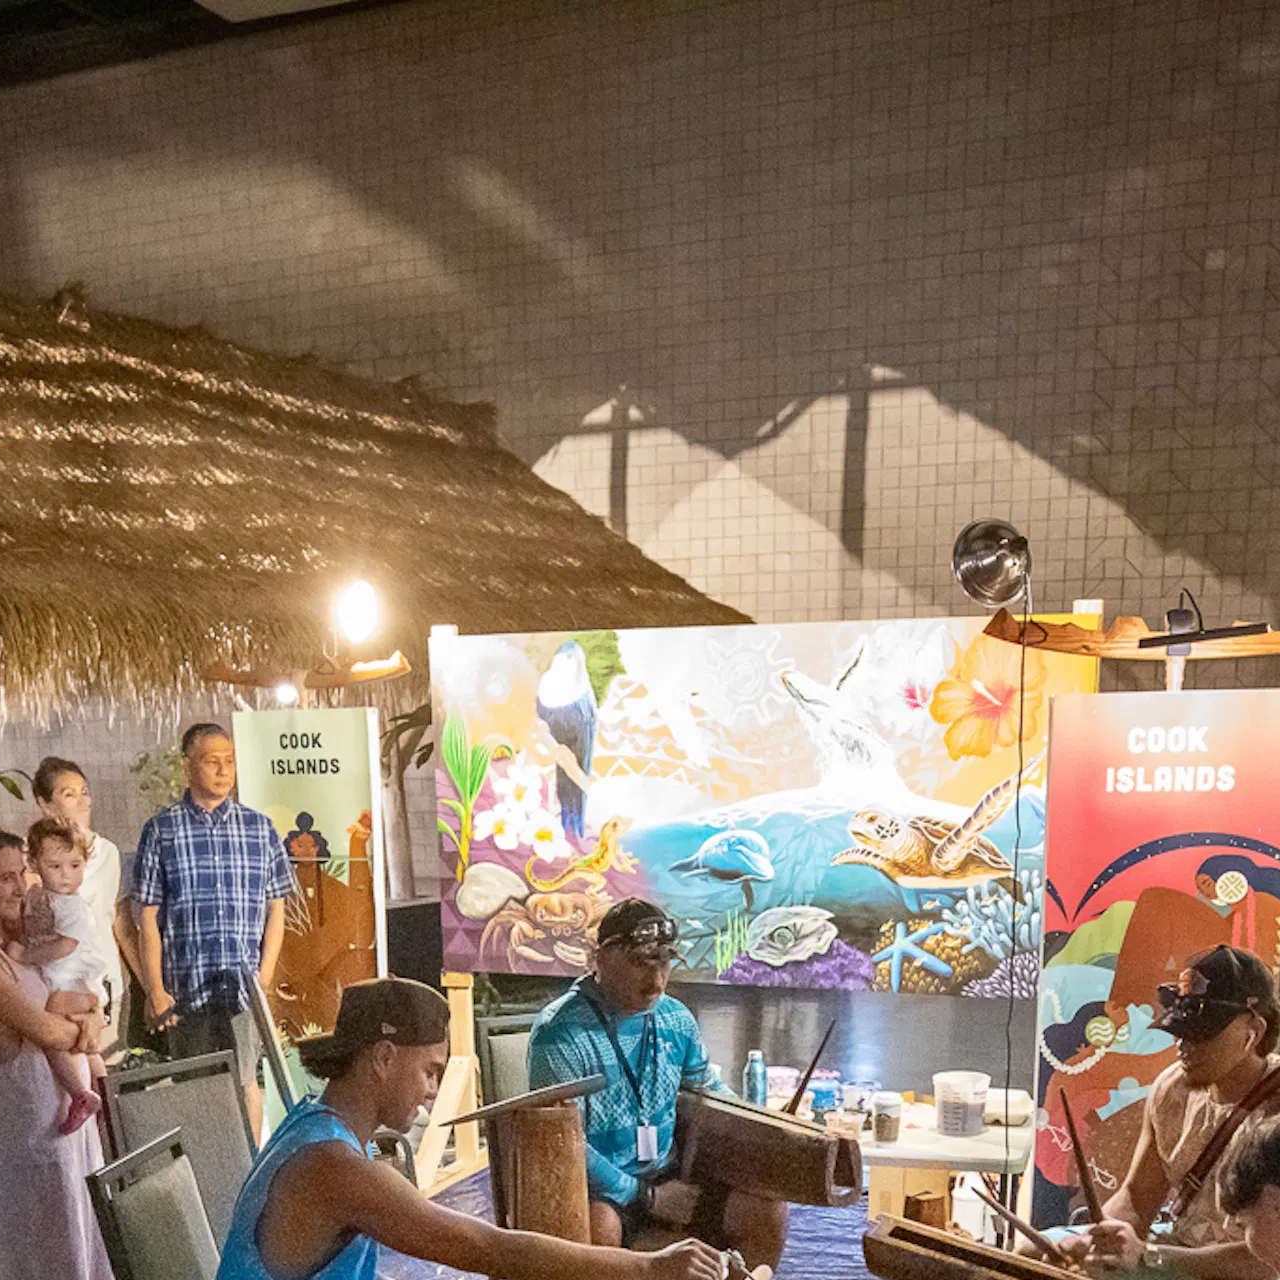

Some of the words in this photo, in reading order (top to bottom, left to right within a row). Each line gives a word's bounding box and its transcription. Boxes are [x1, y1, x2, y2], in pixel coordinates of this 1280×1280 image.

[279, 732, 322, 749] COOK
[1127, 725, 1209, 754] COOK
[270, 758, 340, 775] ISLANDS
[1105, 764, 1236, 794] ISLANDS
